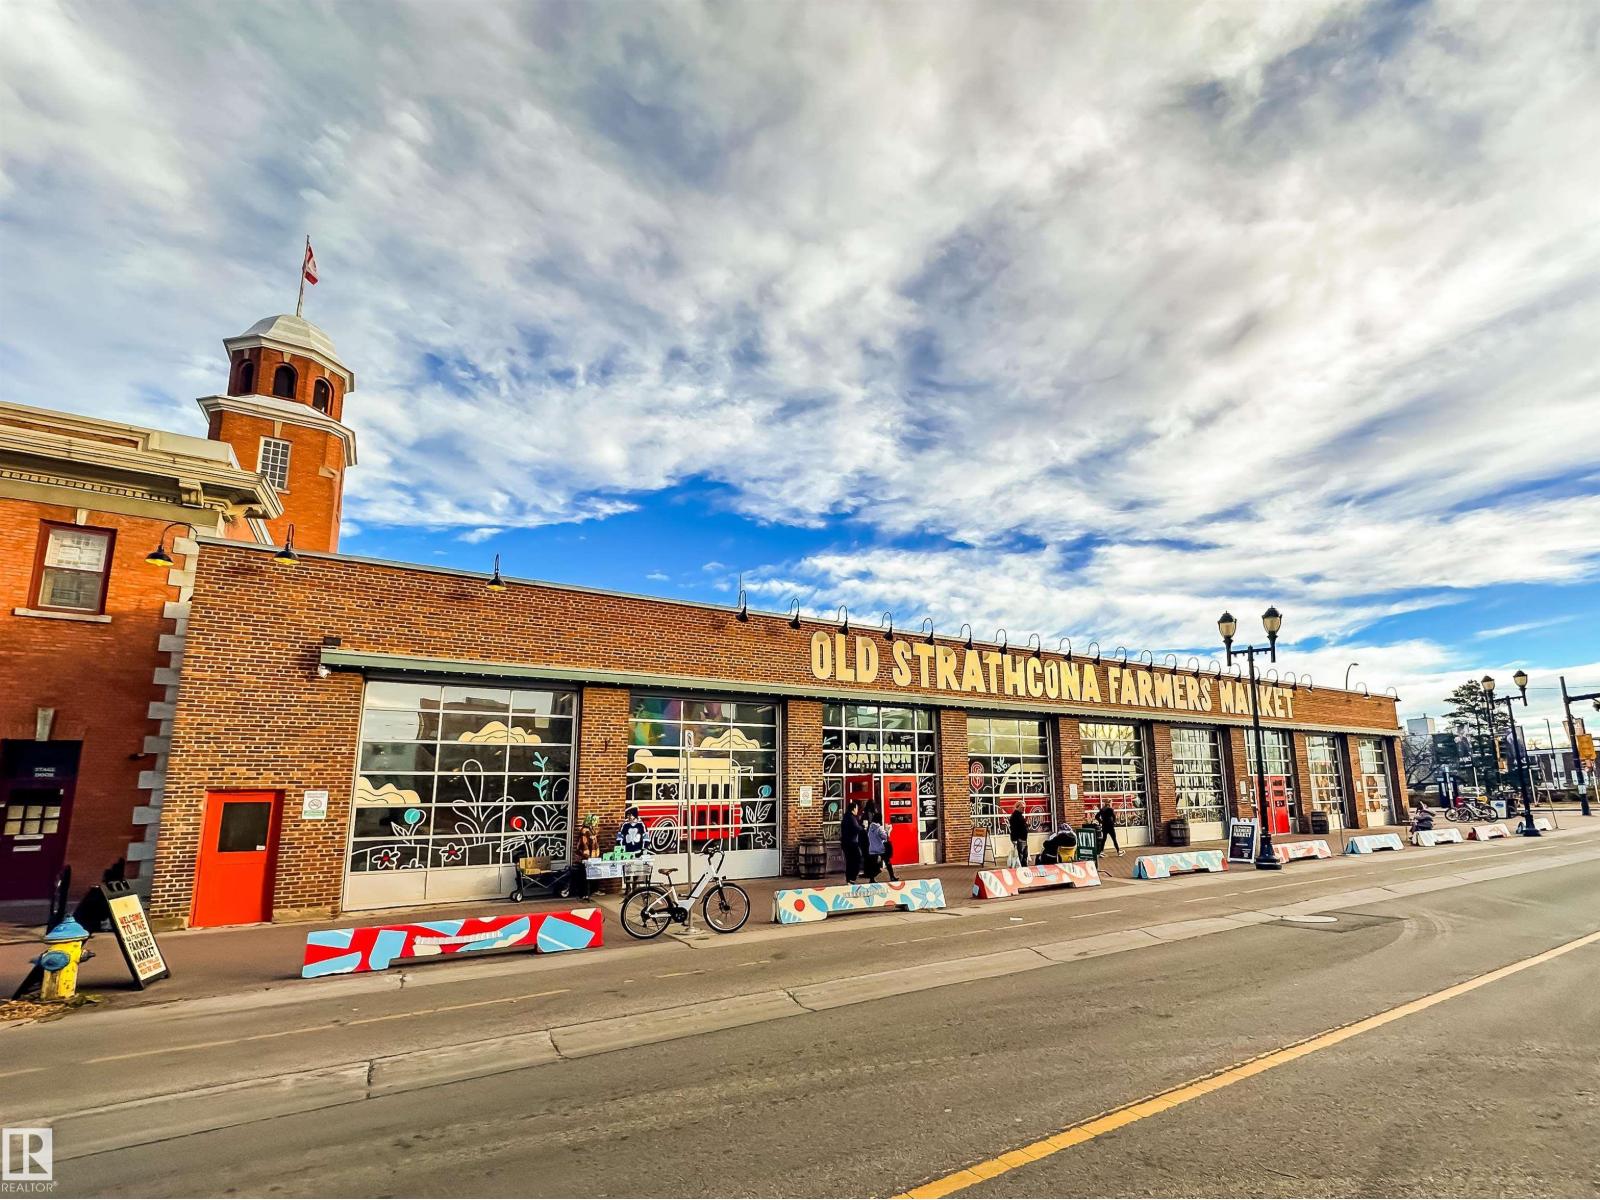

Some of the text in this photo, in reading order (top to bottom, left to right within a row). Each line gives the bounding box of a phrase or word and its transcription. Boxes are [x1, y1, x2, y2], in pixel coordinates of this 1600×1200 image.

[811, 631, 879, 683] OLD
[892, 640, 1102, 703] STRATHCONA
[848, 742, 878, 764] SAT
[883, 743, 912, 764] SUN
[119, 912, 143, 925] WELCOME
[122, 920, 146, 935] TO THE
[132, 946, 157, 963] MARKET
